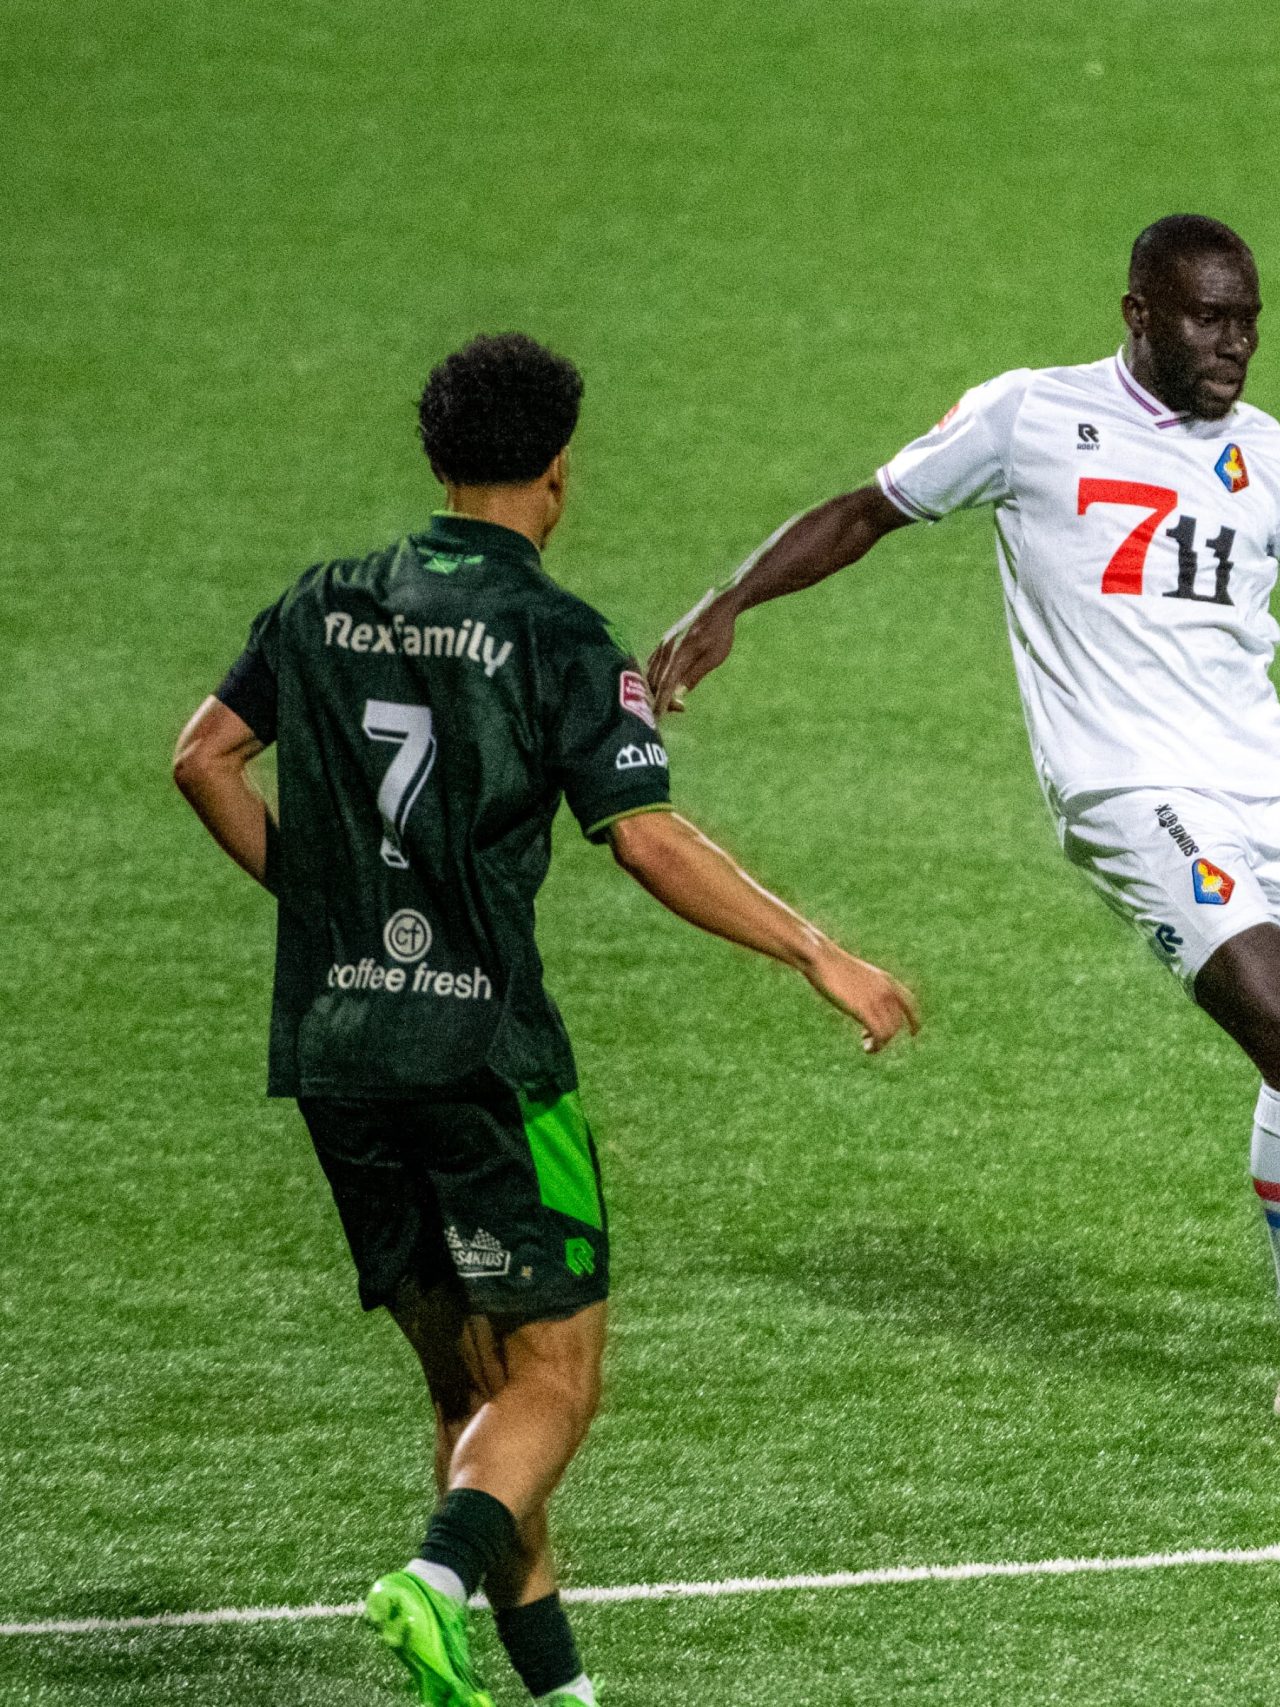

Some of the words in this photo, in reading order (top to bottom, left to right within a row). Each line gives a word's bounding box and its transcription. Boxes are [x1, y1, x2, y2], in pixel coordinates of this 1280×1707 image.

[362, 699, 437, 869] 7
[328, 957, 406, 992] coffee
[412, 962, 492, 1000] fresh
